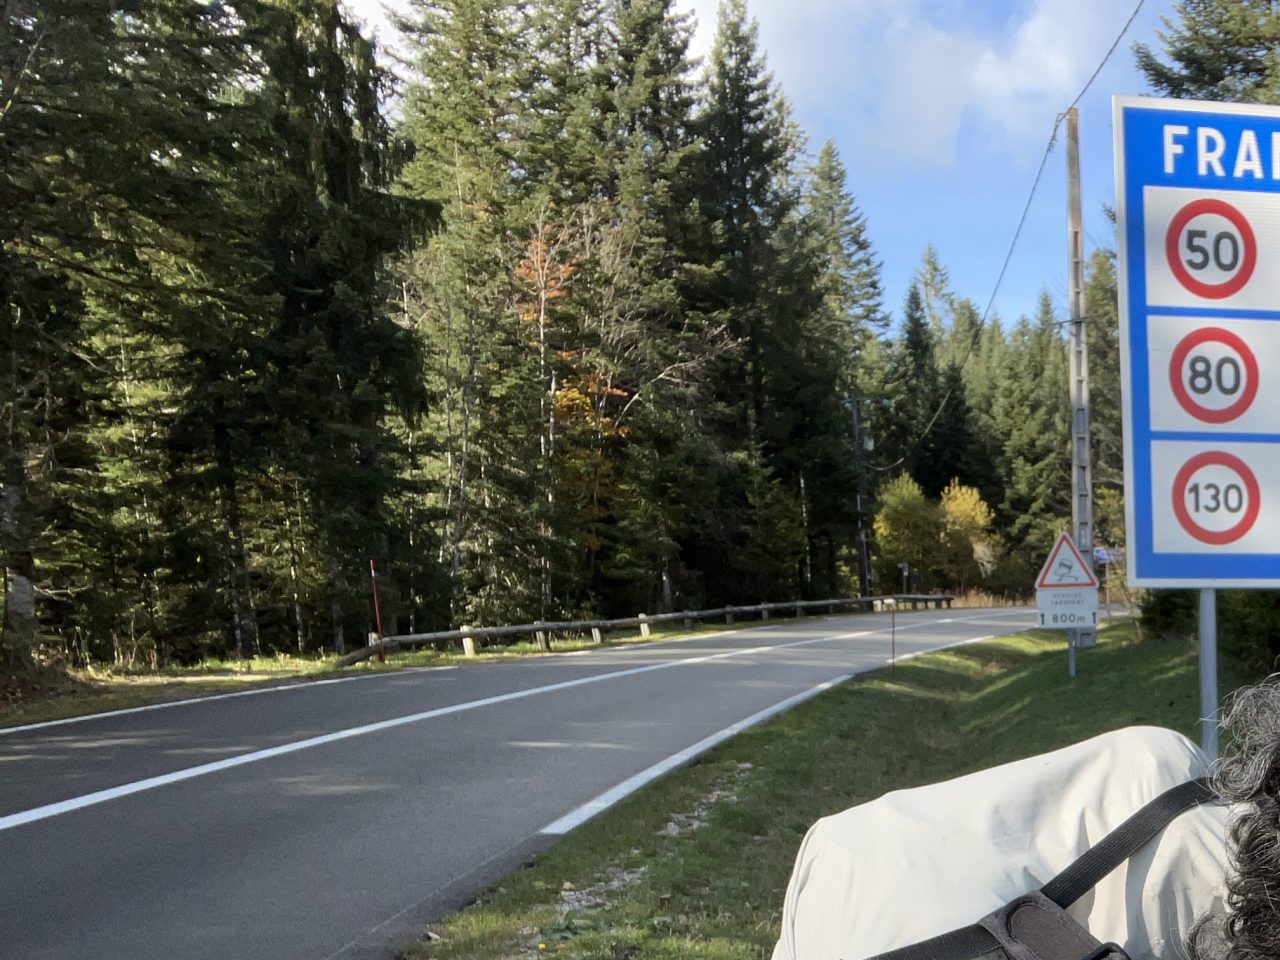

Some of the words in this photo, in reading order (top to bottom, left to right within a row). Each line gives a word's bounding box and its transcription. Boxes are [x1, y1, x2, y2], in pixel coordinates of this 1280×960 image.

[1185, 229, 1239, 272] 50
[1188, 355, 1242, 397] 80
[1187, 482, 1243, 514] 130
